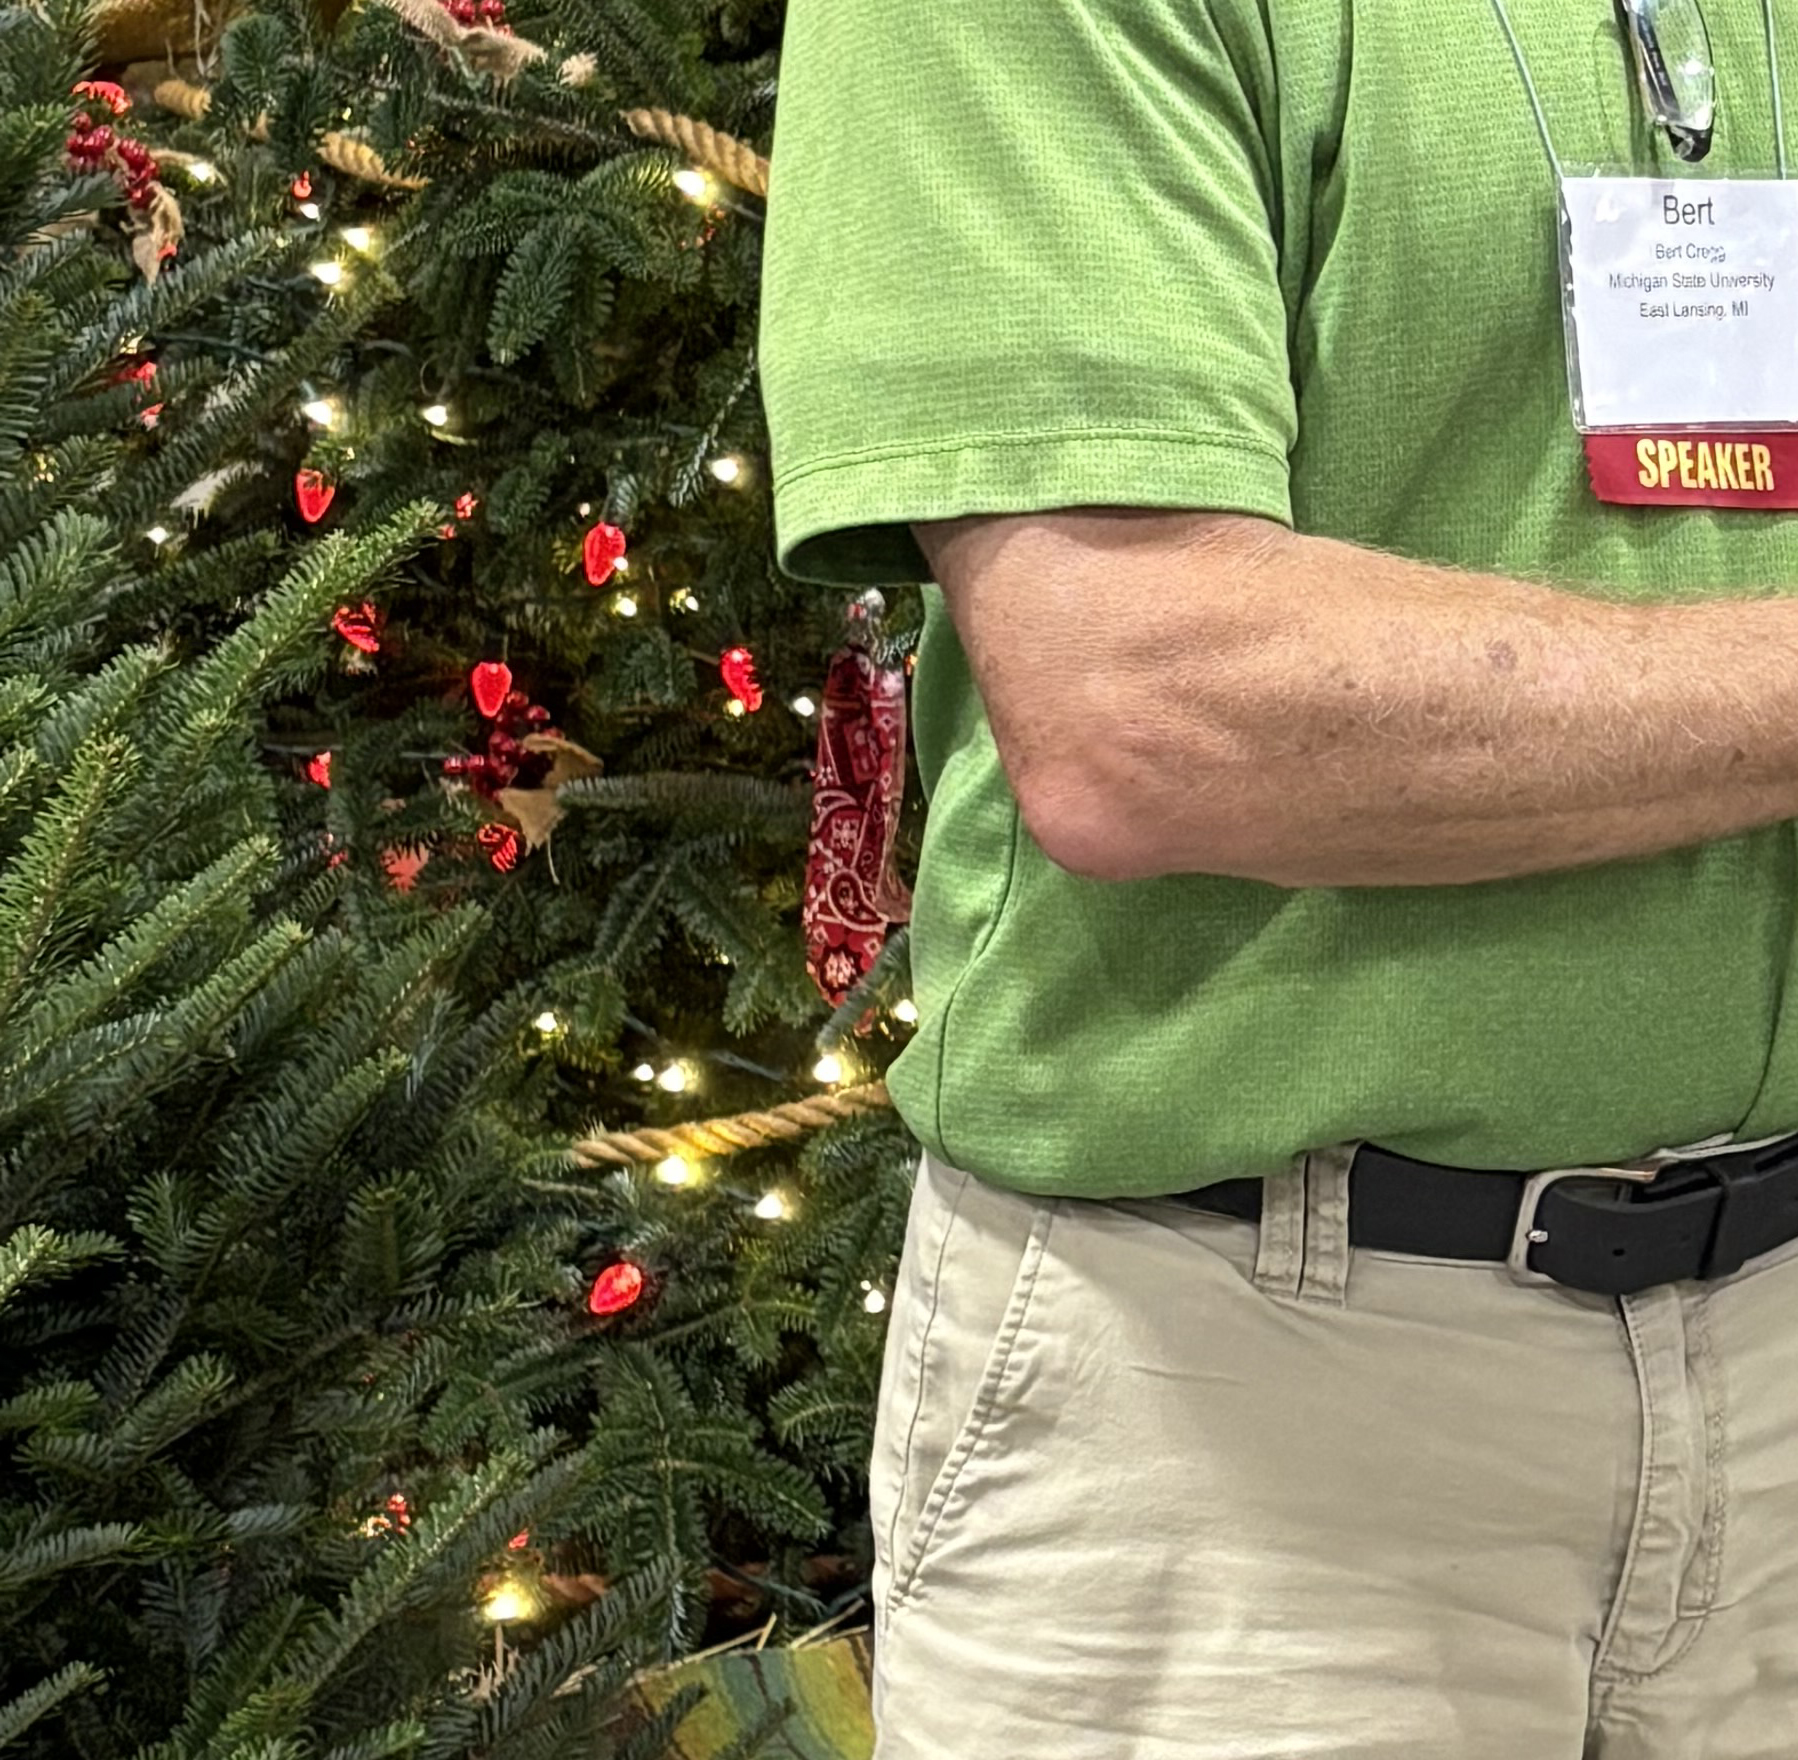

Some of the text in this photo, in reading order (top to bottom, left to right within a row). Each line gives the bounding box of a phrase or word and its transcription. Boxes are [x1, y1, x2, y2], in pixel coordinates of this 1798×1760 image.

[1663, 194, 1715, 225] Bert
[1655, 243, 1682, 259] Bert
[1609, 272, 1775, 292] Michigan State University
[1640, 302, 1669, 318] East
[1732, 300, 1748, 316] MI
[1636, 438, 1775, 491] SPEAKER
